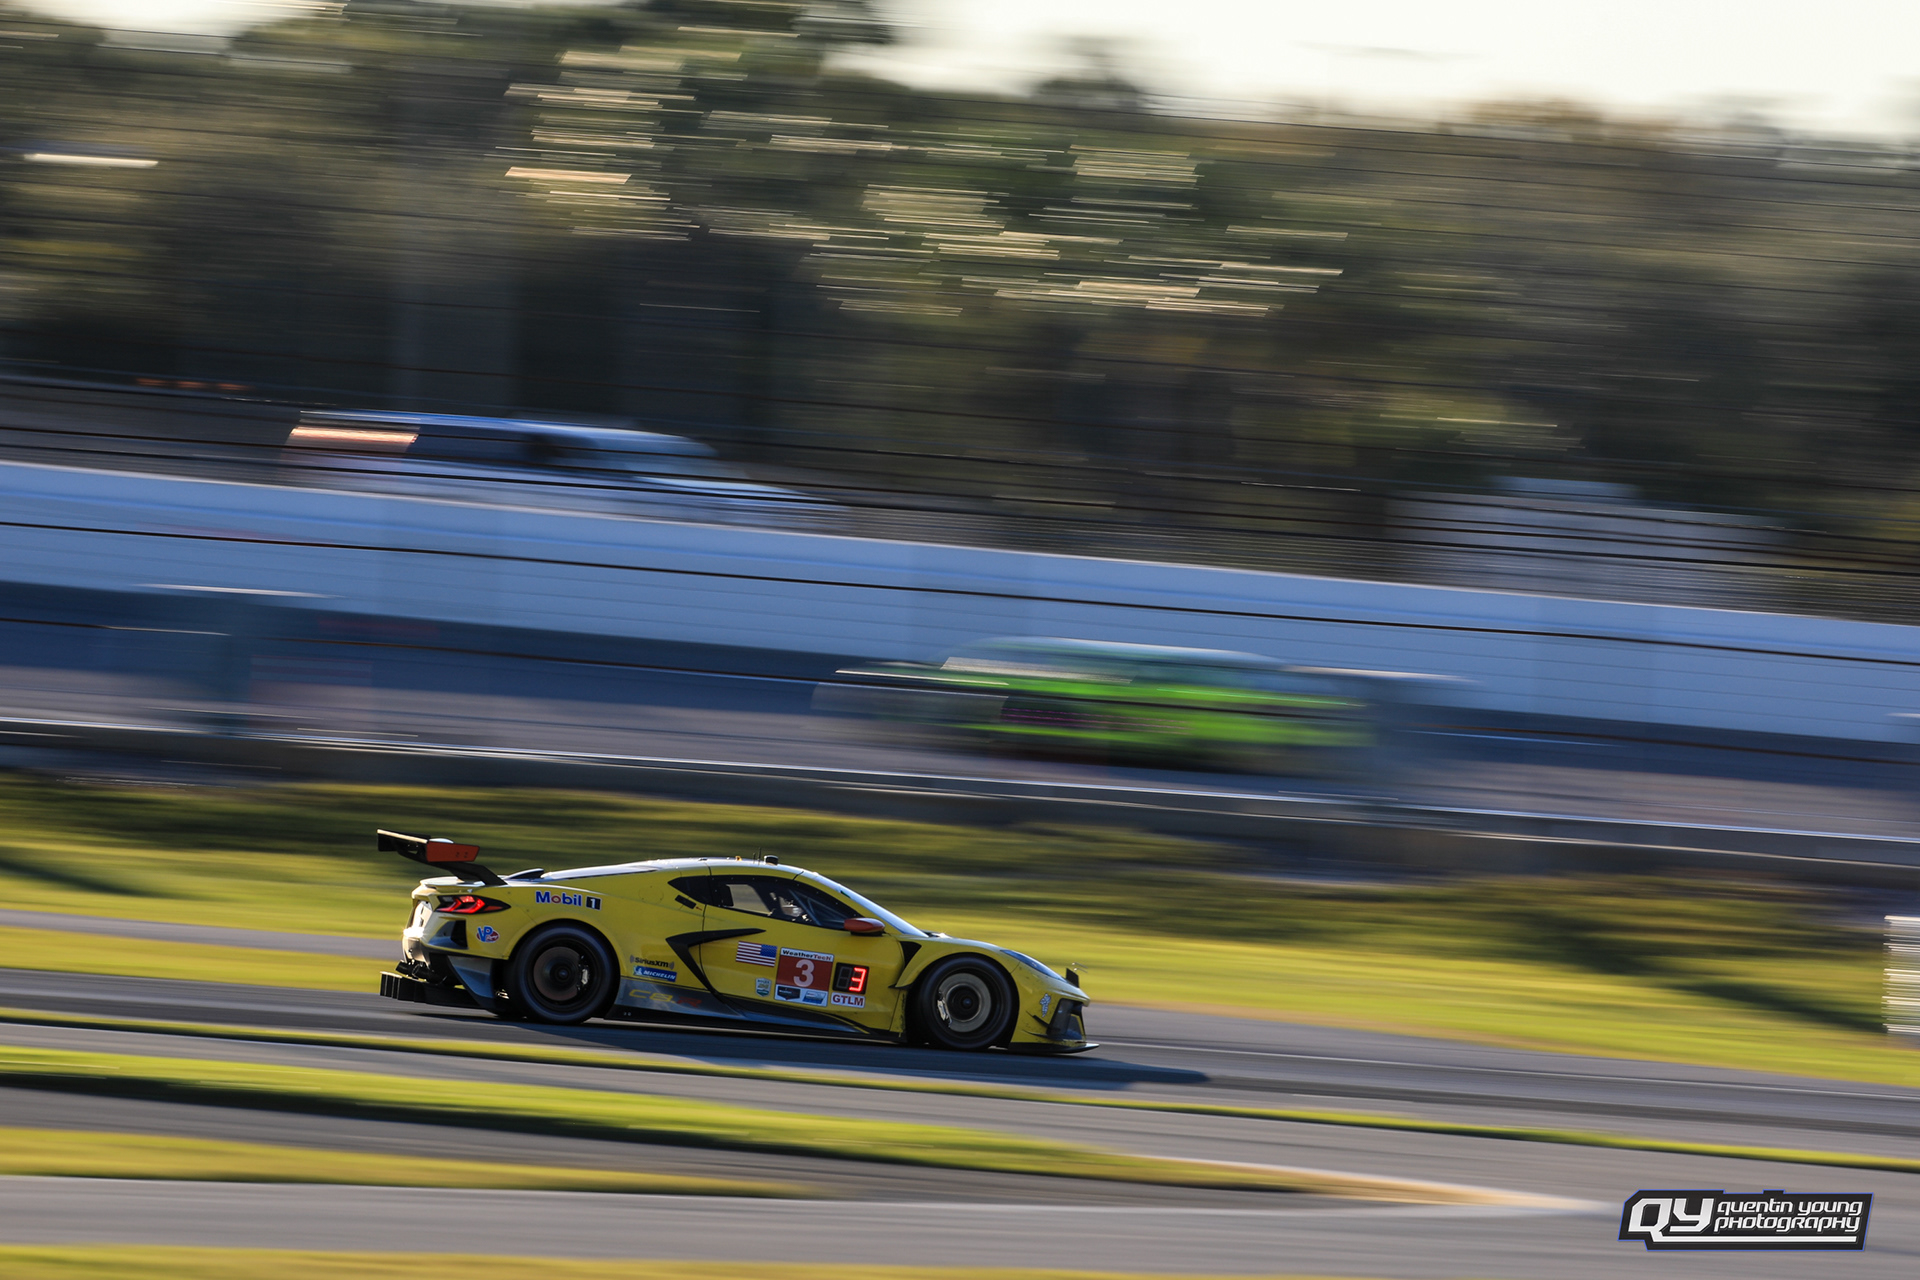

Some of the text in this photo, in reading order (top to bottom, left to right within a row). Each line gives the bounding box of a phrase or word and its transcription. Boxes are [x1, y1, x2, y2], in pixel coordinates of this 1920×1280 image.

[536, 891, 582, 907] Mobil
[477, 926, 494, 942] VP
[643, 970, 676, 980] MICHELIN
[793, 959, 815, 987] 3
[849, 967, 866, 992] 3
[832, 994, 864, 1007] GTLM
